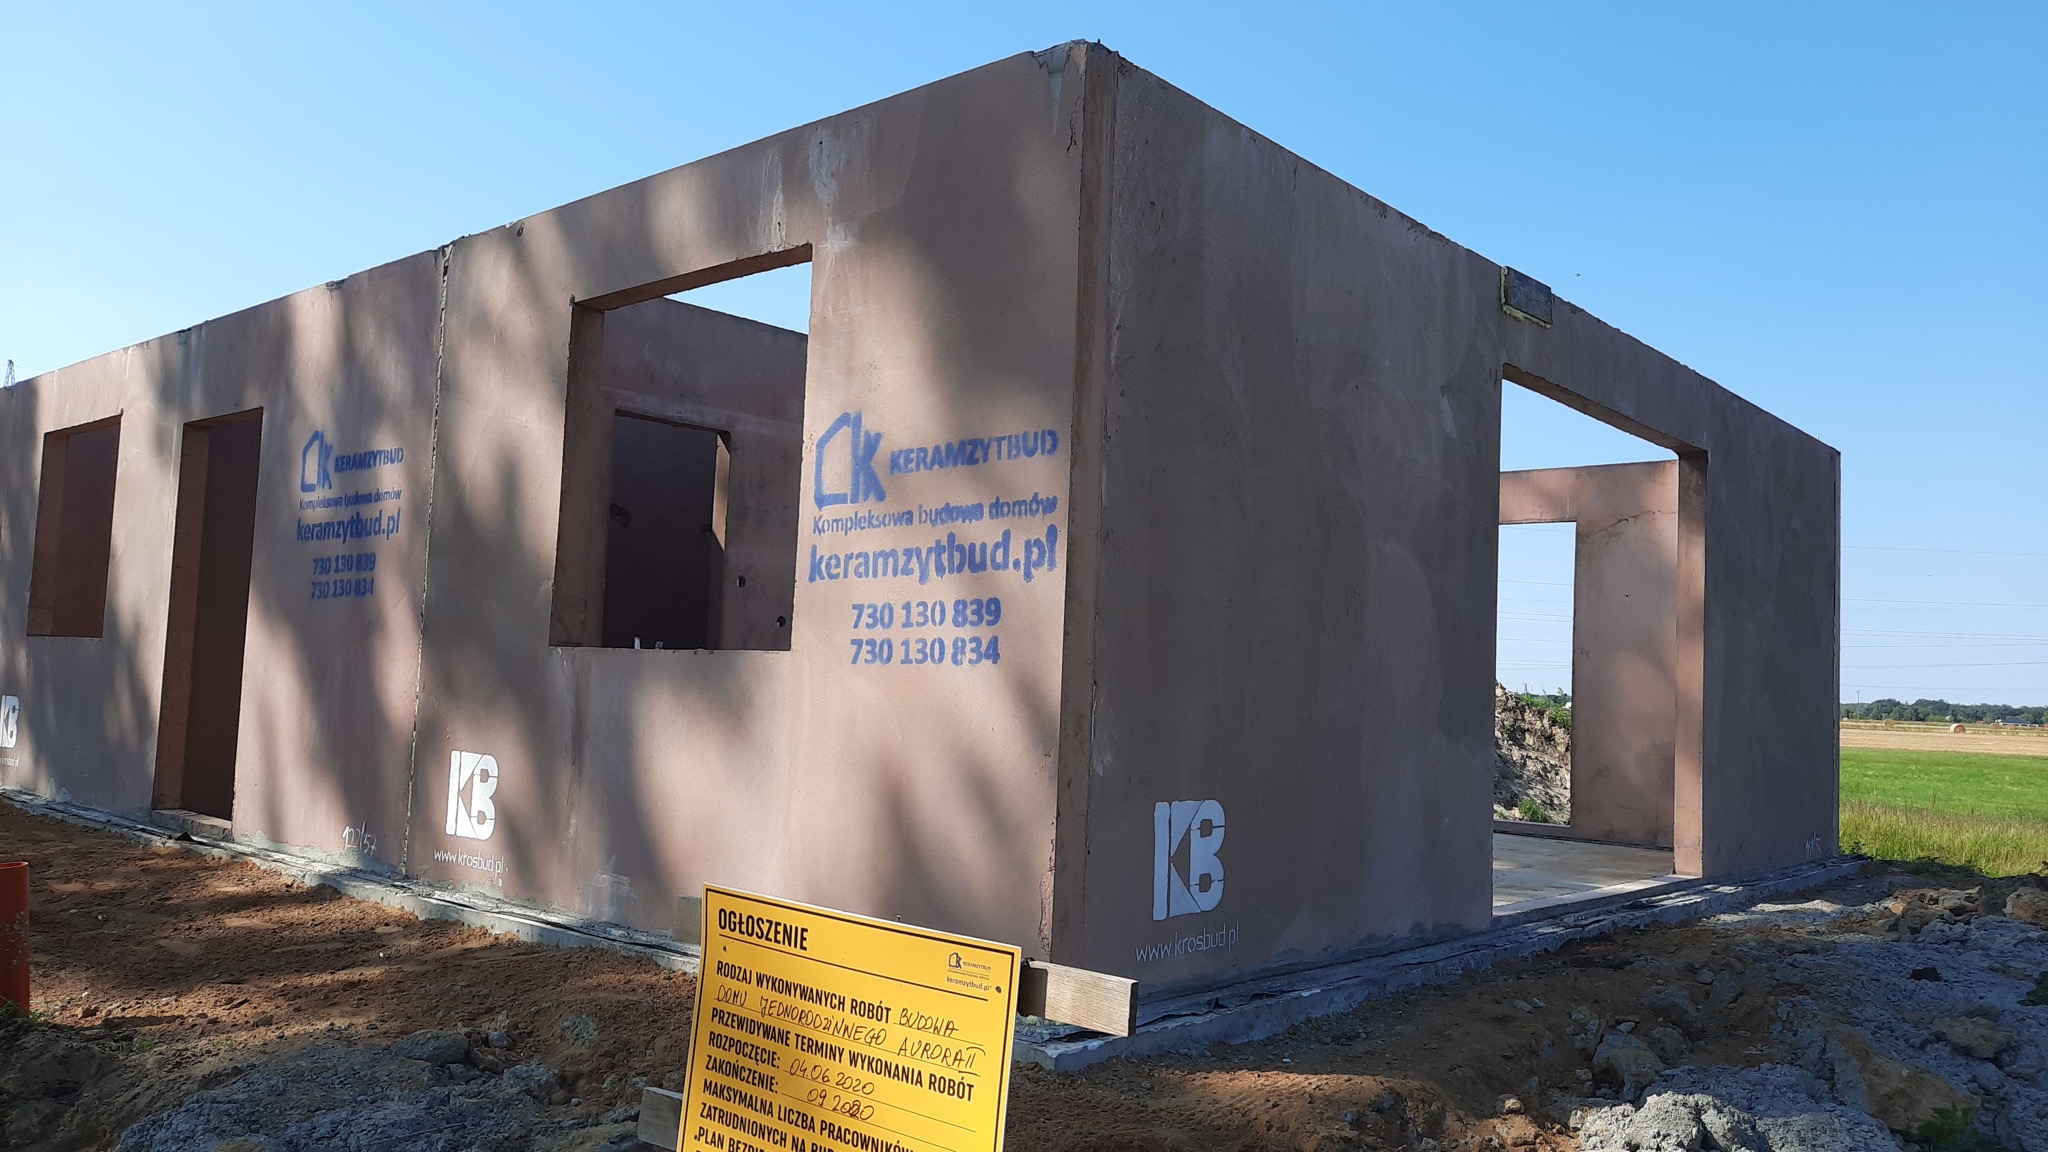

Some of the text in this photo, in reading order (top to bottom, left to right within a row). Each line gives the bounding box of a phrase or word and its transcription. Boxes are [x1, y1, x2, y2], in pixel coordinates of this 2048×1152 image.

[334, 446, 404, 473] KERAMZYTBUD
[890, 429, 1059, 476] KERAMZYTBUD
[296, 508, 401, 544] keramzytbud.pl
[813, 491, 1058, 536] Kompleksowa budowa domów
[312, 556, 332, 575] 730
[333, 554, 354, 573] 130
[808, 523, 1058, 585] keramzytbud.pl
[311, 580, 330, 599] 730
[331, 578, 352, 597] 130
[851, 597, 1001, 629] 730 130 839
[850, 635, 1000, 665] 730 130 834
[445, 750, 498, 840] KB
[1152, 799, 1226, 921] KB
[718, 907, 809, 952] OGŁOSZENIE
[716, 960, 892, 1024] RODZAJ WYKONYWANYCH ROBÓT
[717, 984, 748, 1007] DOMU
[898, 1007, 960, 1038] BUDOWA
[708, 1030, 781, 1069] ROZPOCZĘCIE:
[711, 1006, 975, 1102] PRZEWIDYWANE TERMINY WYKONANIA ROBÓT
[705, 1054, 779, 1094] ZAKOŃCZENIE:
[835, 1072, 875, 1095] 2020
[702, 1078, 774, 1118] MAKSYMALNA
[777, 1104, 816, 1133] LICZBA
[806, 1088, 827, 1107] 09
[697, 1126, 725, 1150] PLAN
[699, 1101, 806, 1152] ZATRUDNIONYCH NA
